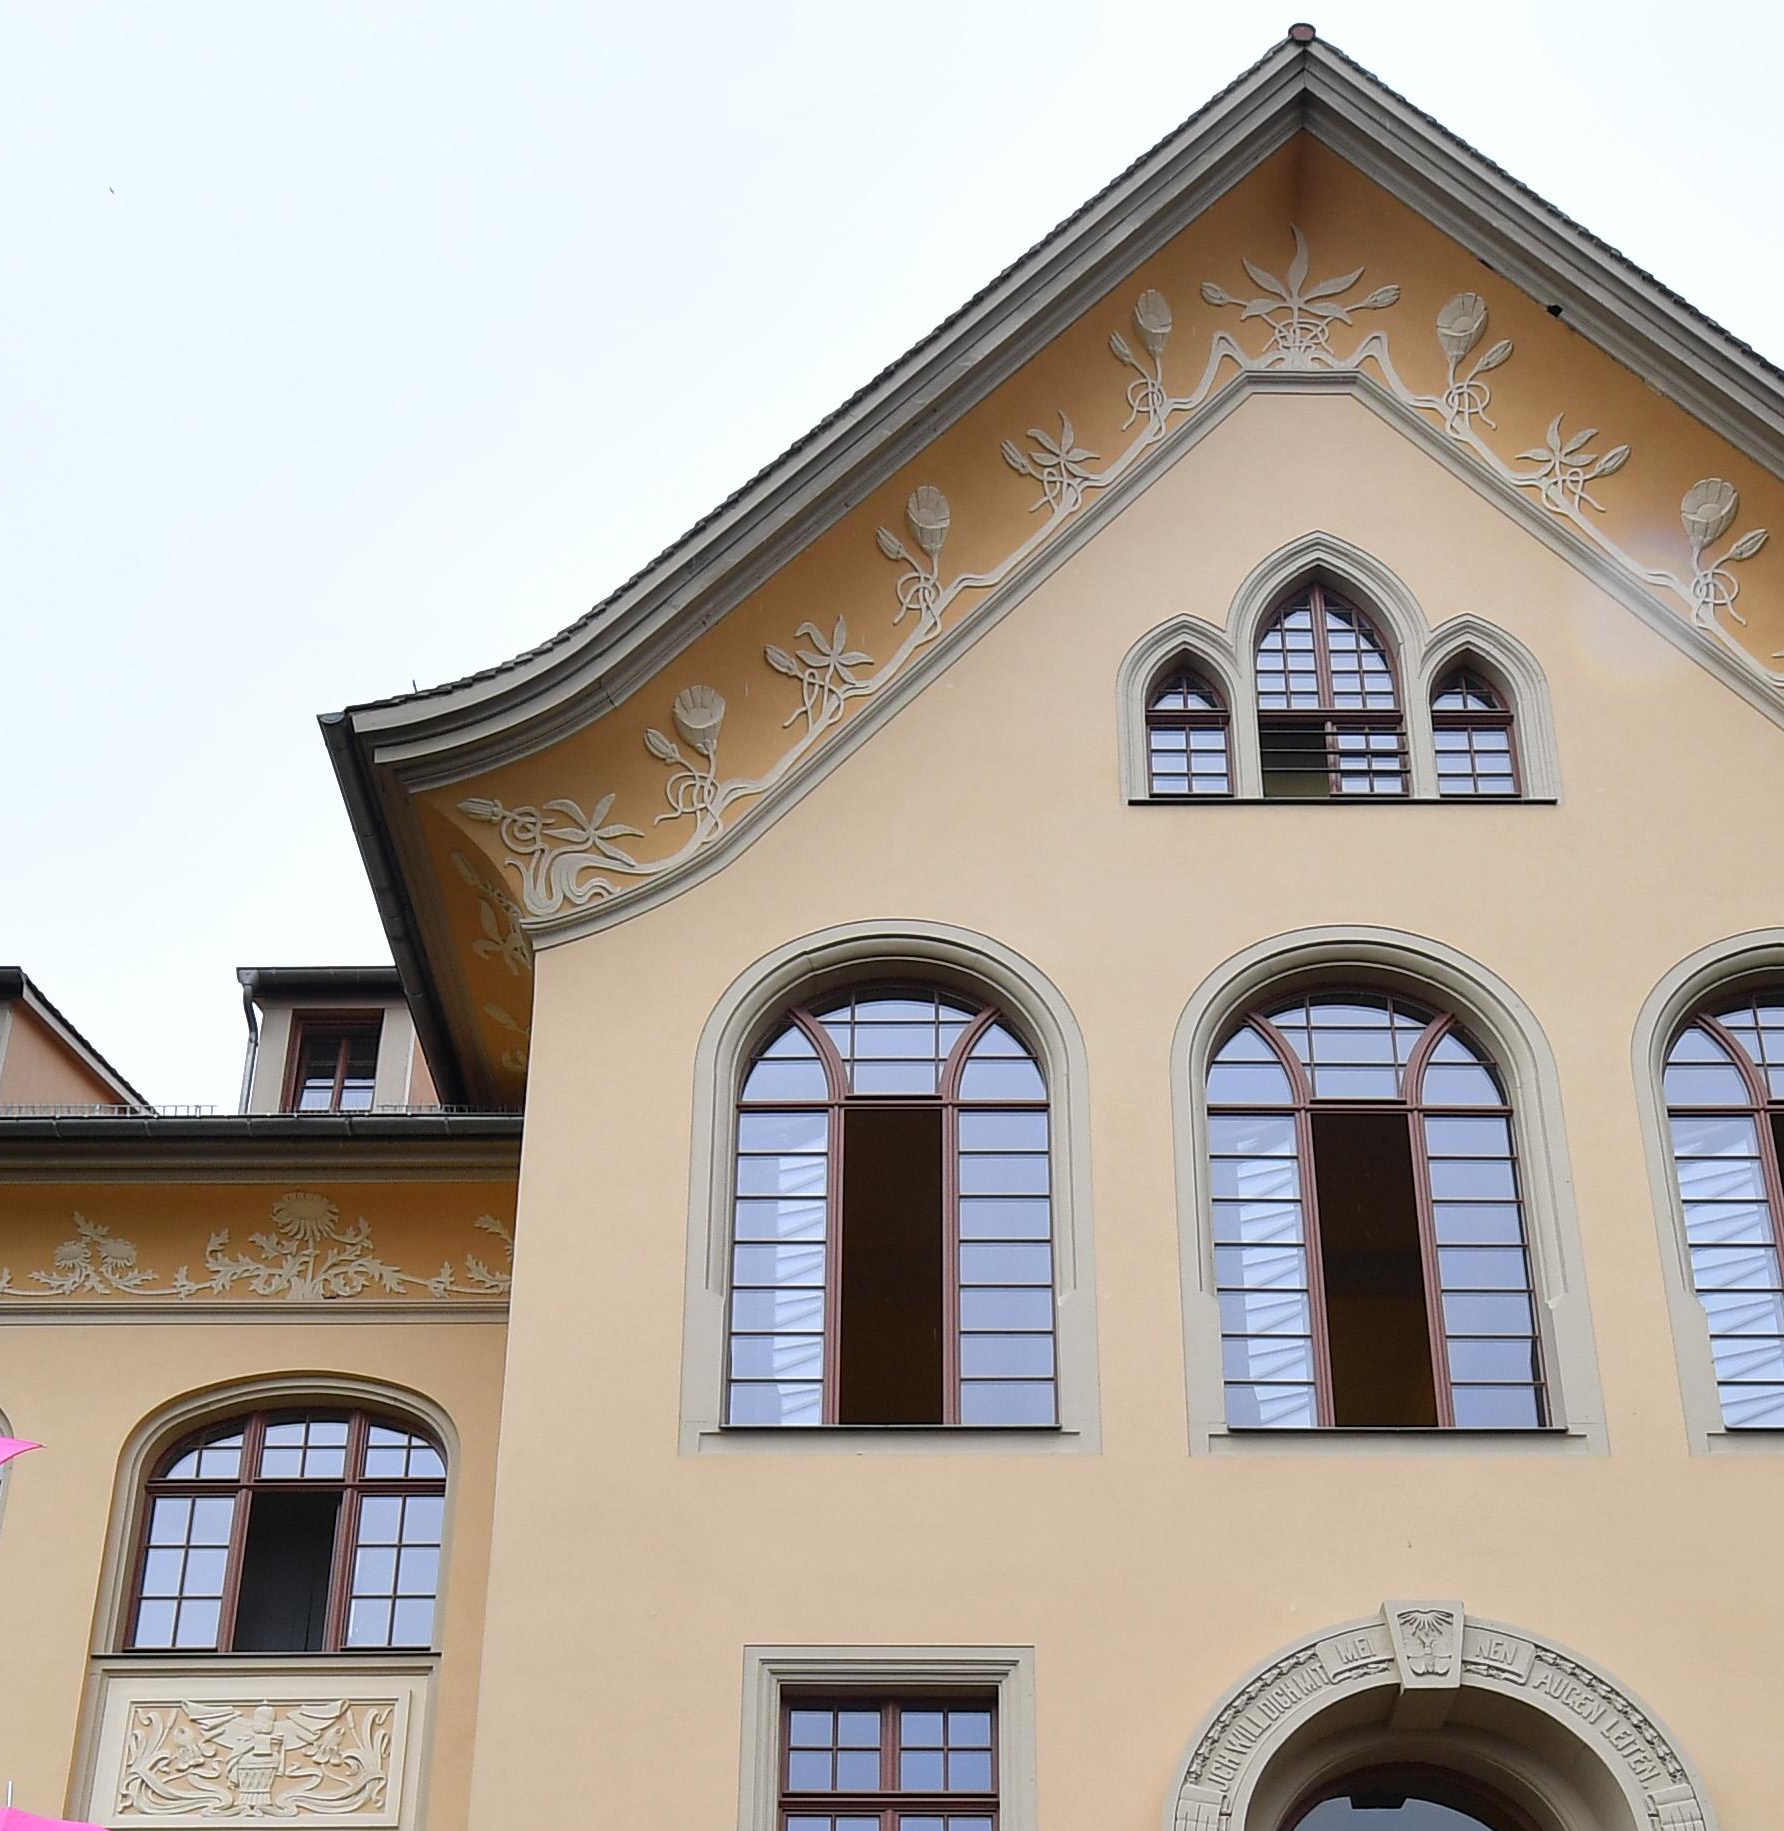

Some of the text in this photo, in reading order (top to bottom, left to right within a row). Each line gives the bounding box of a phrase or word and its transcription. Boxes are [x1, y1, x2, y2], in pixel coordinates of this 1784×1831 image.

[1224, 1713, 1272, 1756] WILL
[1256, 1682, 1302, 1722] DICH
[1296, 1664, 1330, 1697] MIT
[1475, 1638, 1519, 1666] NEN
